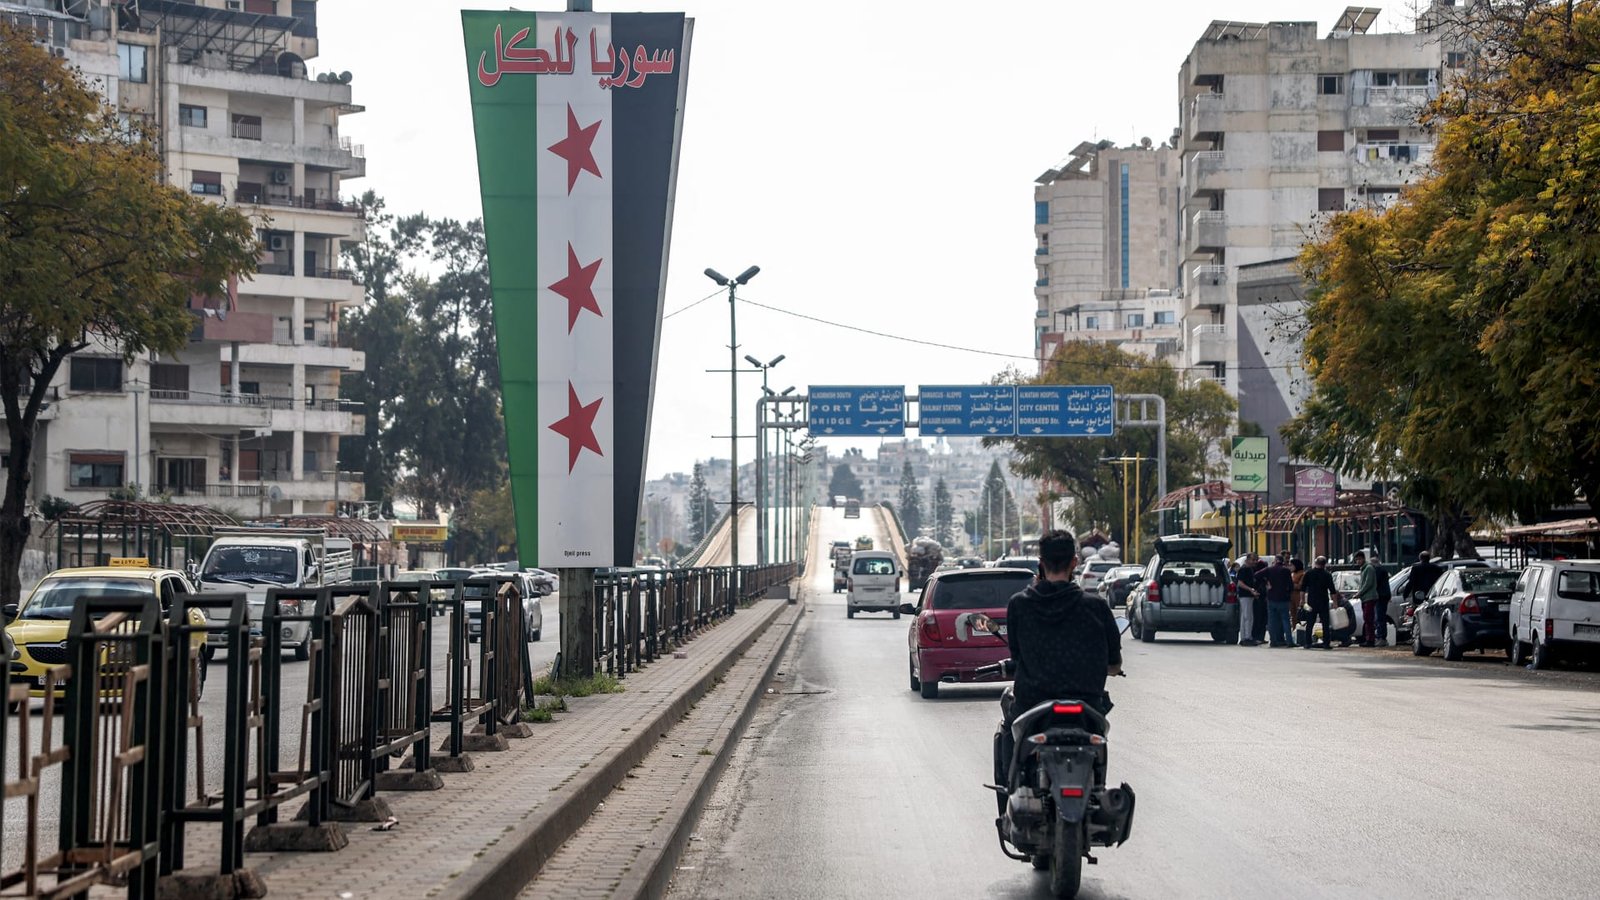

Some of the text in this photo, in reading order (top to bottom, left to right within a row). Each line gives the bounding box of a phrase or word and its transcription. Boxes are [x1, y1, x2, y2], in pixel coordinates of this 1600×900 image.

[477, 23, 675, 88] سوريا للكل
[1067, 389, 1090, 401] الوطني
[1067, 401, 1111, 414] مركز المدينة
[811, 417, 852, 425] BRIDGE
[861, 418, 901, 428] جسر
[1097, 414, 1111, 427] شارع
[1234, 450, 1266, 463] صيدلية
